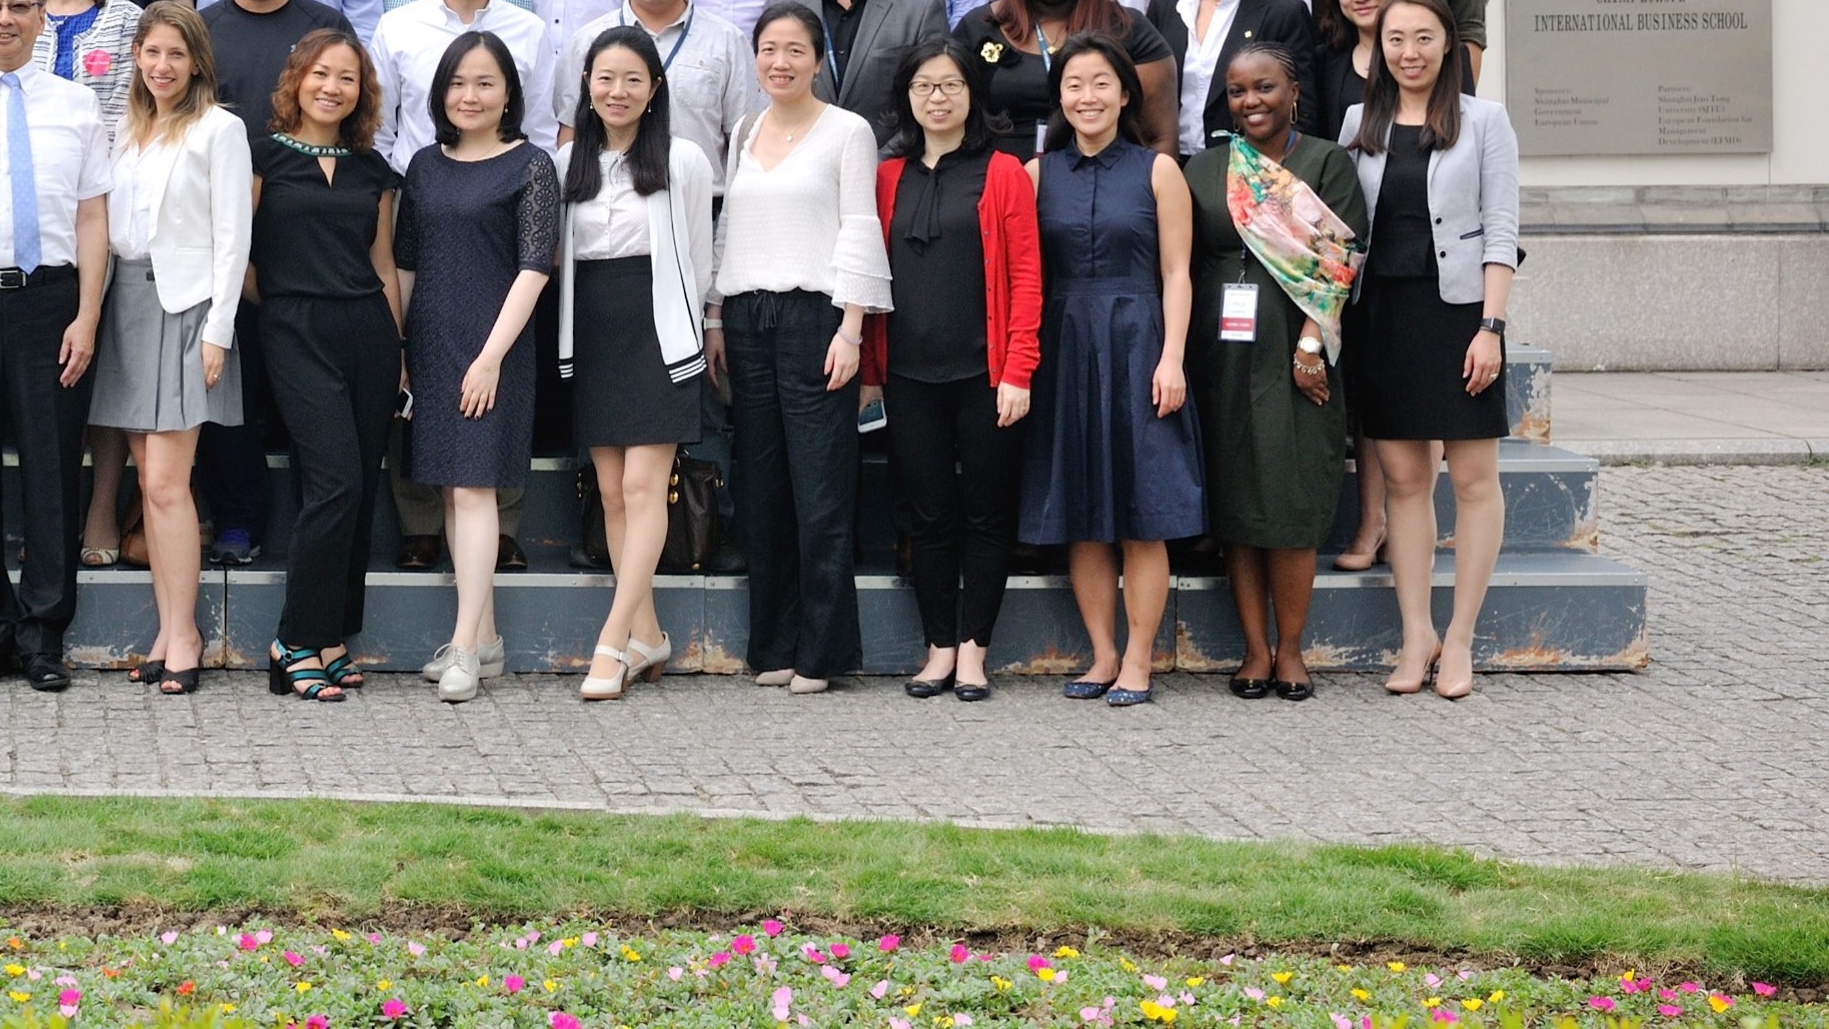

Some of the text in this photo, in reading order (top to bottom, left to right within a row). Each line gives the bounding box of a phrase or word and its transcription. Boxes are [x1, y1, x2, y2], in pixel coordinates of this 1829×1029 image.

[1534, 12, 1748, 32] INTERNATIONAL BUSINESS SCHOOL
